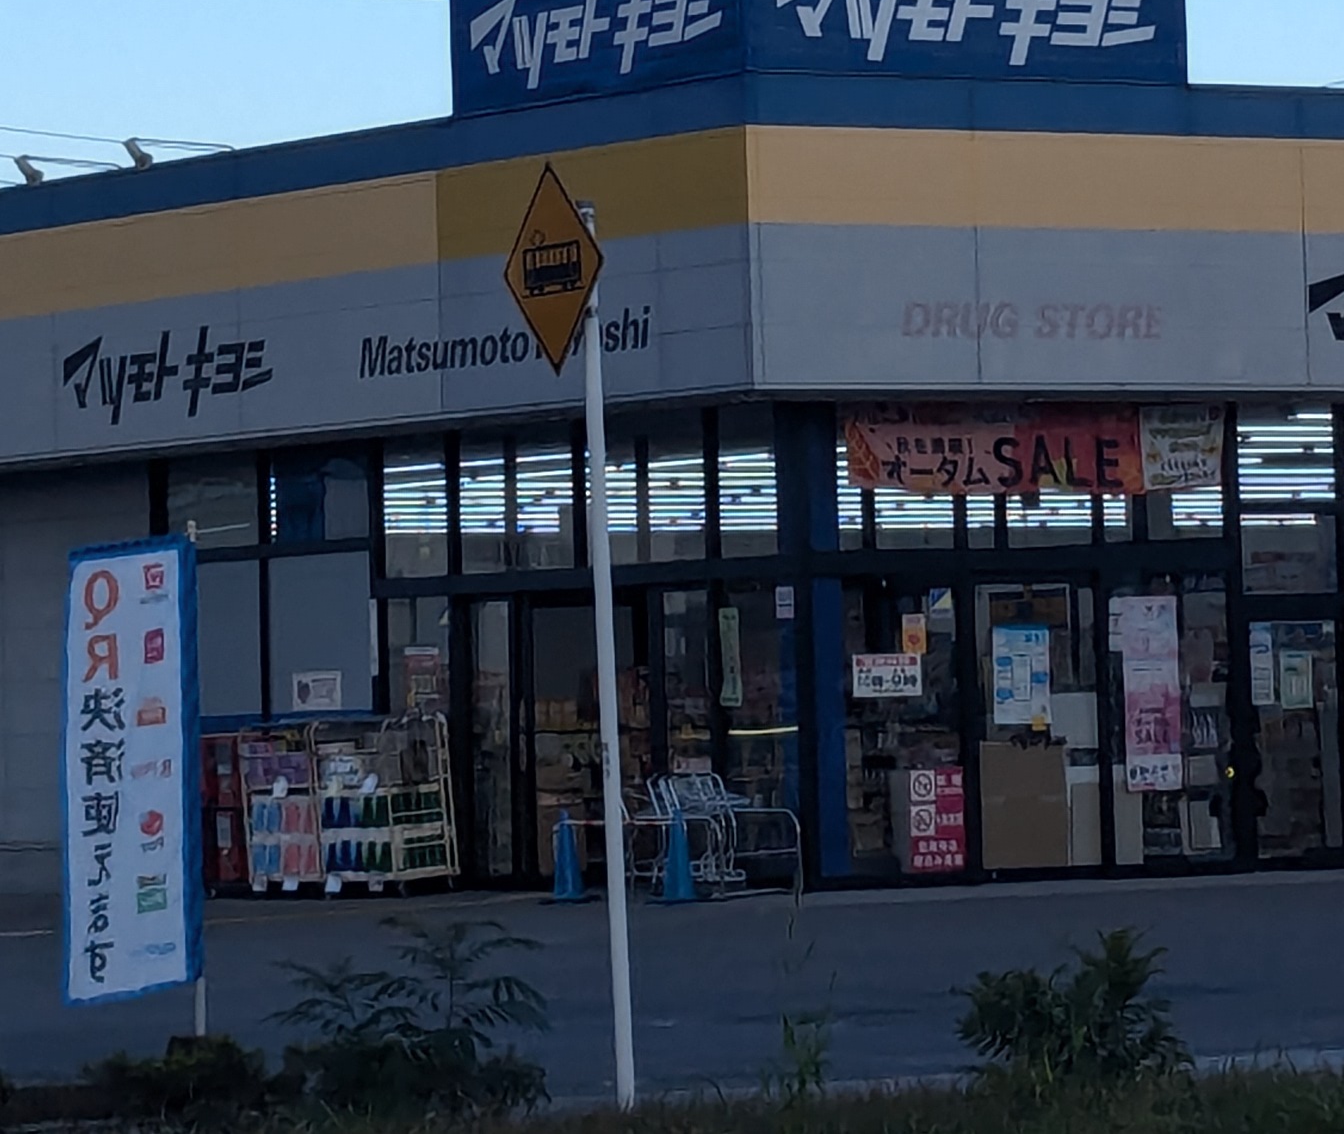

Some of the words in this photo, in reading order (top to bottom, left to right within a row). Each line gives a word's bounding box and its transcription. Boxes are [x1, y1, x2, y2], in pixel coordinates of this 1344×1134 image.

[902, 302, 1019, 339] DRUG
[1034, 303, 1161, 340] STORE
[63, 326, 273, 425] マツモトキヨシ
[359, 327, 529, 379] Matsumoto
[881, 455, 990, 487] オータム
[993, 435, 1124, 489] SALE
